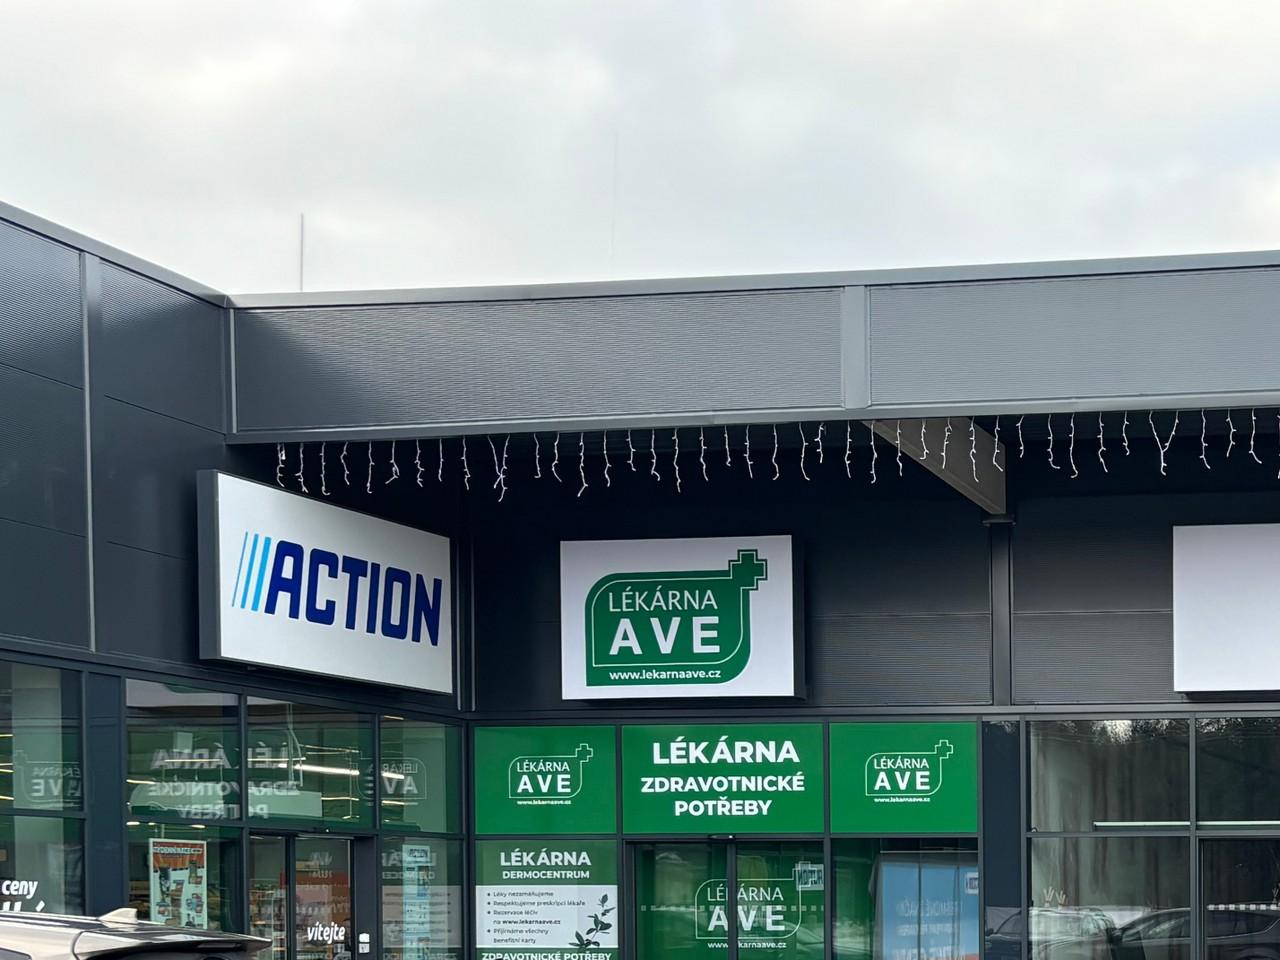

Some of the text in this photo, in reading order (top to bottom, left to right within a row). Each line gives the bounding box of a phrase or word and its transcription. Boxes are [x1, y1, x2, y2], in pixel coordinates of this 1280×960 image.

[264, 540, 442, 646] ACTION
[609, 585, 718, 612] LÉKÁRNA
[609, 616, 720, 655] AVE
[609, 669, 721, 681] www.lekarnaave.cz
[652, 735, 800, 765] LÉKÁRNA
[517, 760, 570, 772] LÉKÁRNA
[874, 755, 929, 769] LÉKÁRNA
[517, 774, 571, 793] AVE
[641, 771, 805, 793] ZDRAVOTNICKÉ
[874, 771, 930, 790] AVE
[675, 796, 772, 816] POTŘEBY
[500, 848, 592, 866] LÉKÁRNA
[502, 870, 590, 879] DERMOCENTRUM
[1, 879, 38, 899] ceny
[707, 905, 785, 931] AVE
[307, 922, 345, 944] vítejte
[481, 950, 612, 960] ZDRAVOTNICKÉ POTŘEBY
